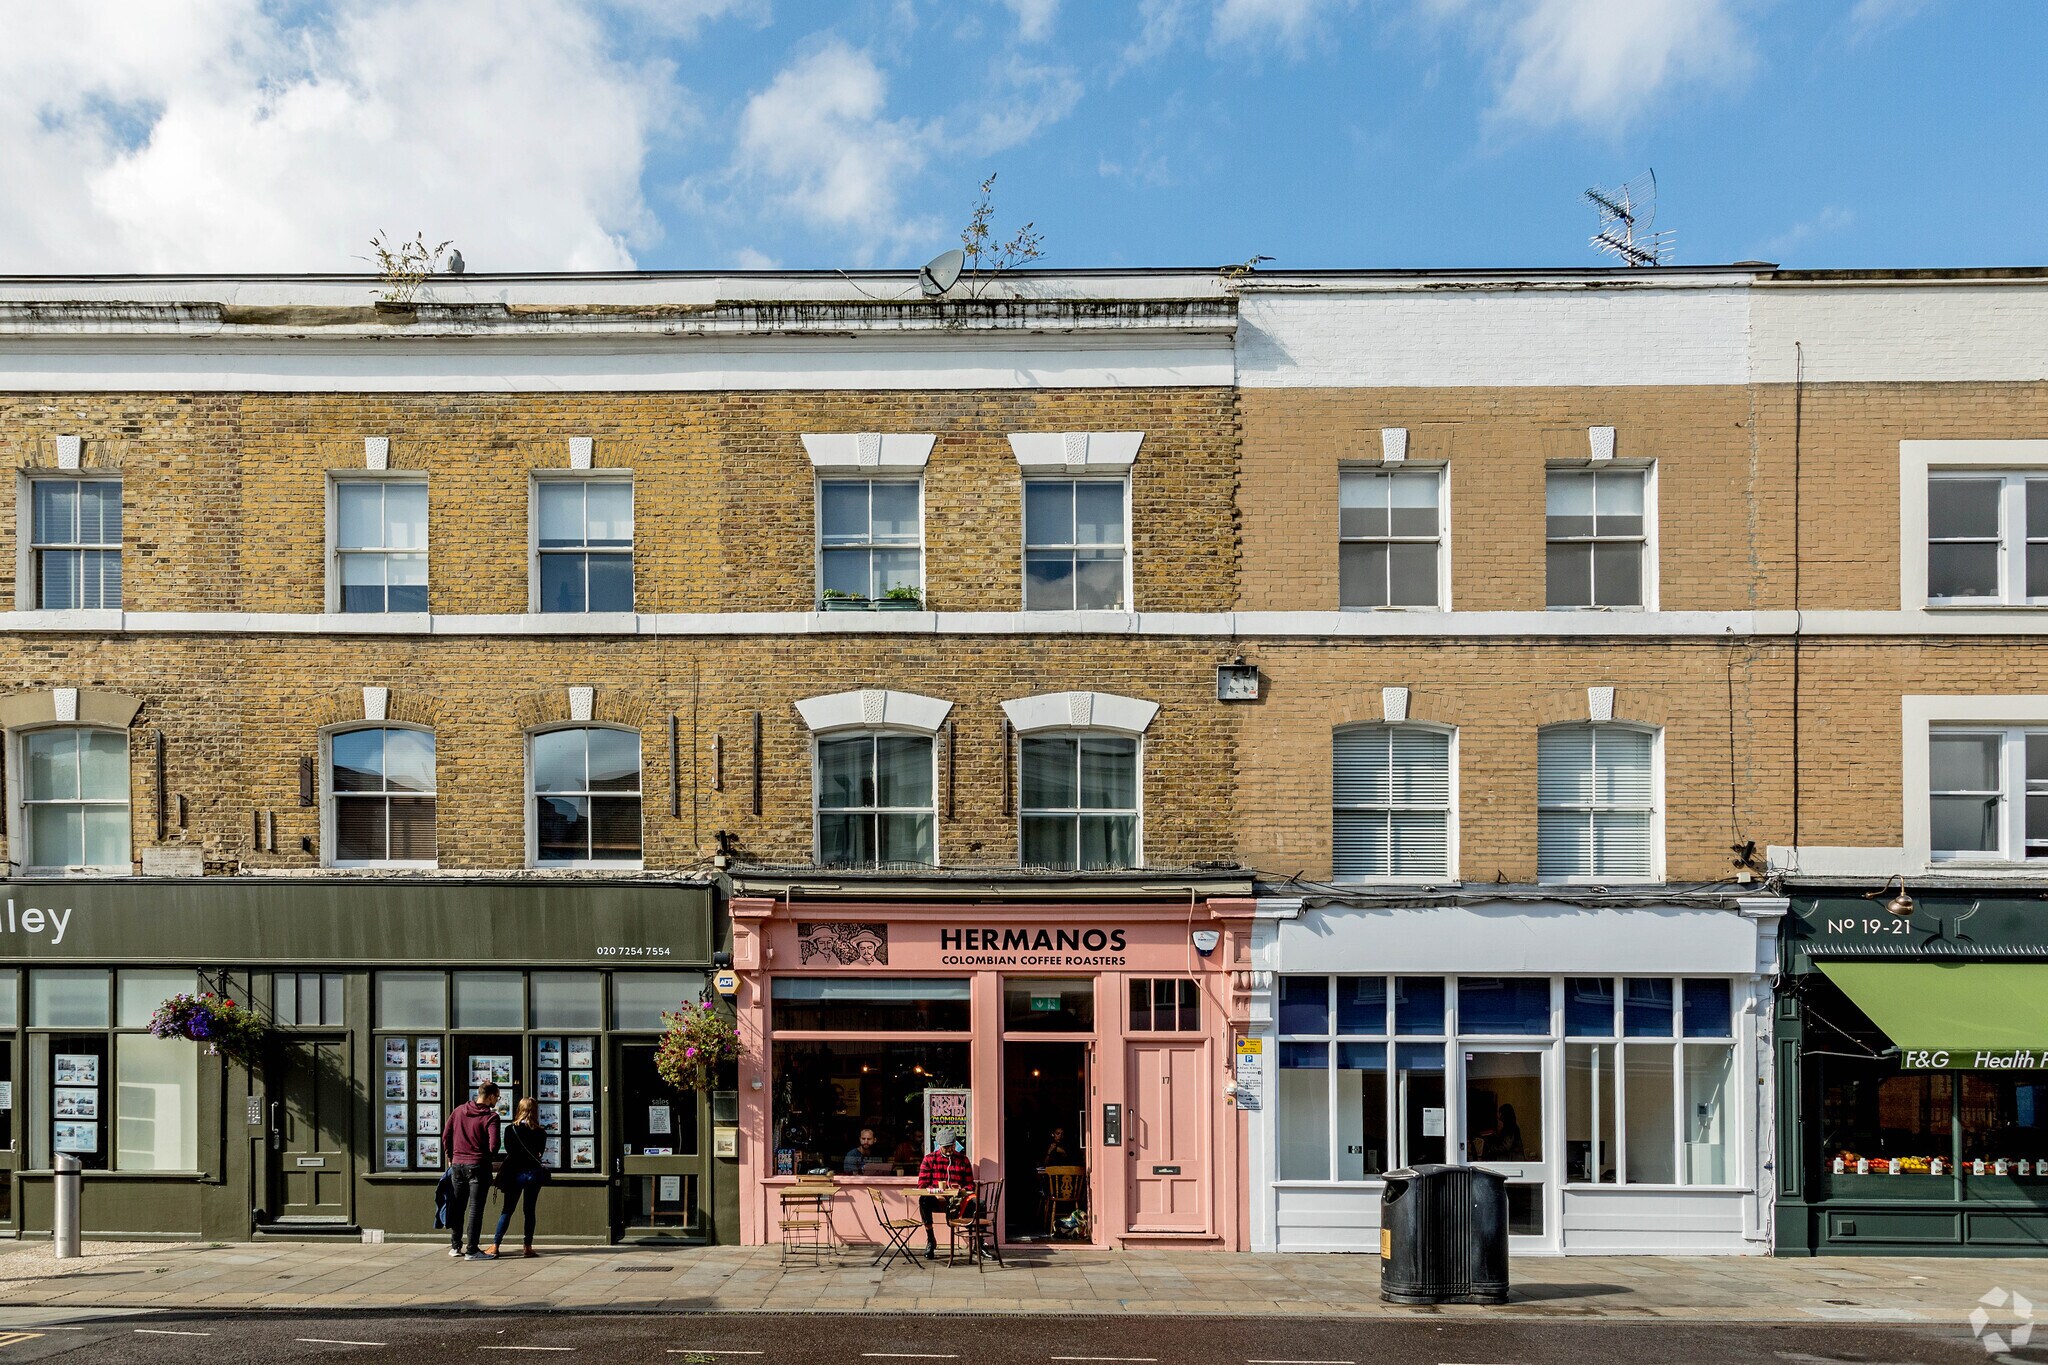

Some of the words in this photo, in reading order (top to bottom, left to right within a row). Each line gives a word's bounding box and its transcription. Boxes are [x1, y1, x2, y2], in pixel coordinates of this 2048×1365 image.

[0, 899, 72, 945] ley
[1861, 919, 1910, 934] 19-21
[940, 928, 1127, 952] HERMANOS
[596, 946, 617, 955] 020
[618, 946, 643, 956] 7254
[645, 947, 671, 956] 7554
[942, 955, 1017, 965] COLOMBIAN
[1020, 955, 1062, 966] COFFEE
[1065, 956, 1126, 966] ROASTERS
[1906, 1050, 1949, 1068] F&G
[1973, 1050, 2035, 1068] Health
[1162, 1076, 1170, 1085] 17
[651, 1097, 669, 1105] sales
